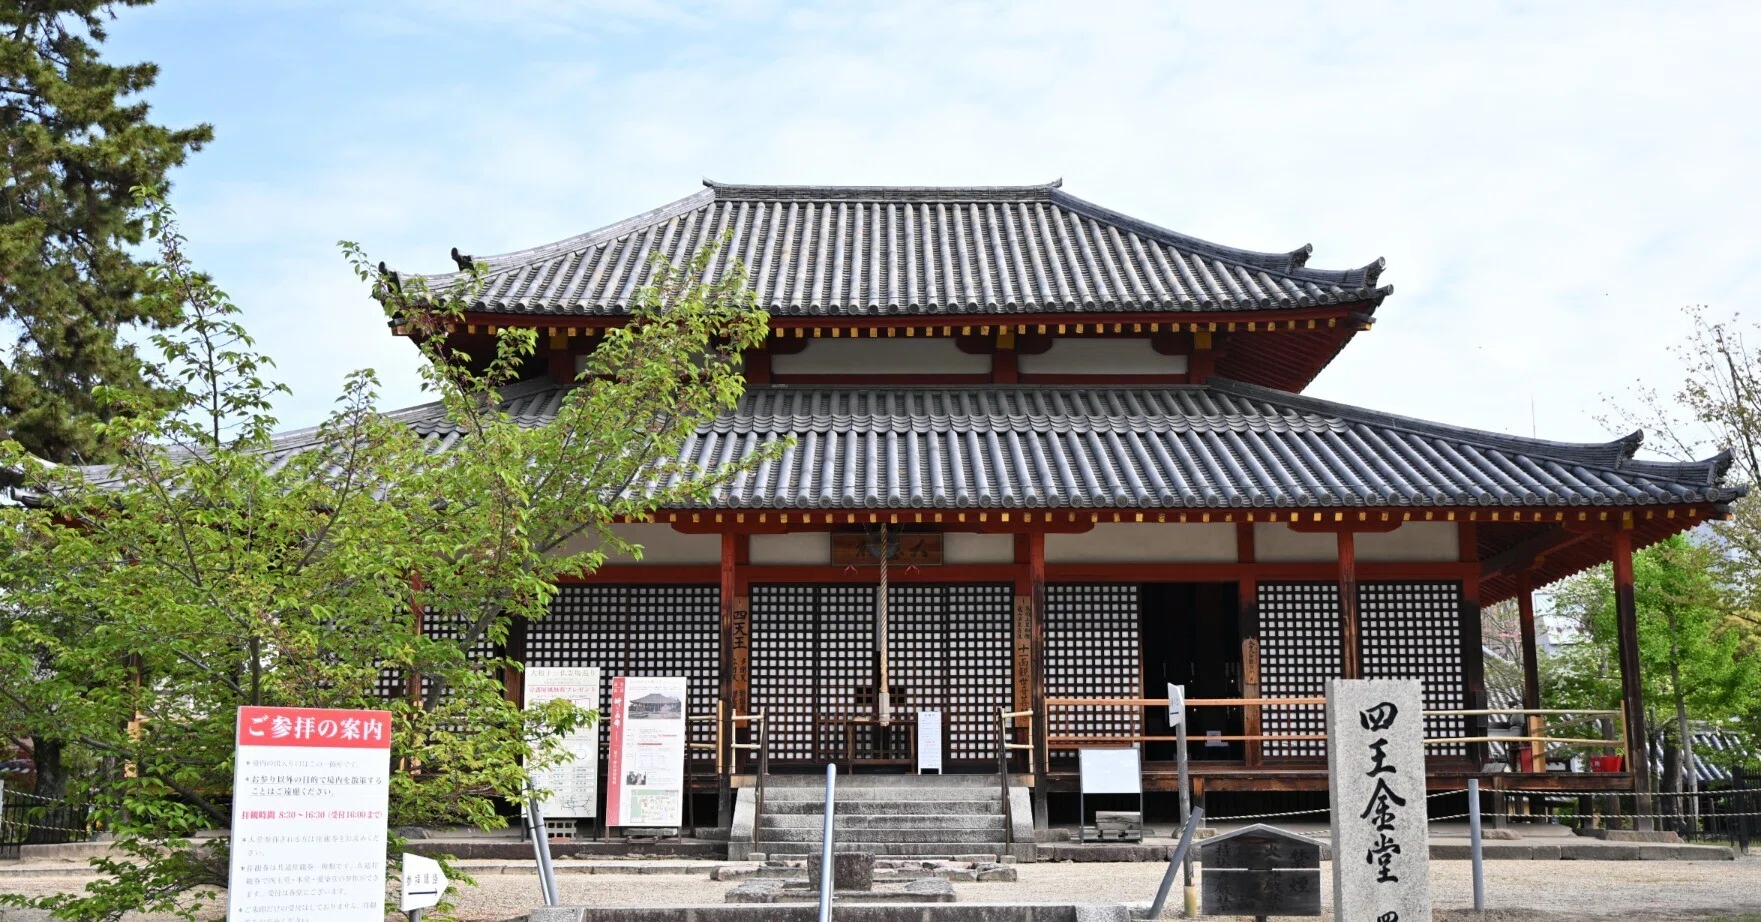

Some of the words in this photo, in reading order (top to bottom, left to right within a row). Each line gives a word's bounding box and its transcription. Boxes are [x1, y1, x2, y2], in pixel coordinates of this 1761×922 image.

[733, 611, 747, 650] 四天王
[249, 715, 383, 741] ご参拝の案内
[1359, 702, 1406, 883] 四王金堂
[241, 811, 275, 820] 拝観時間
